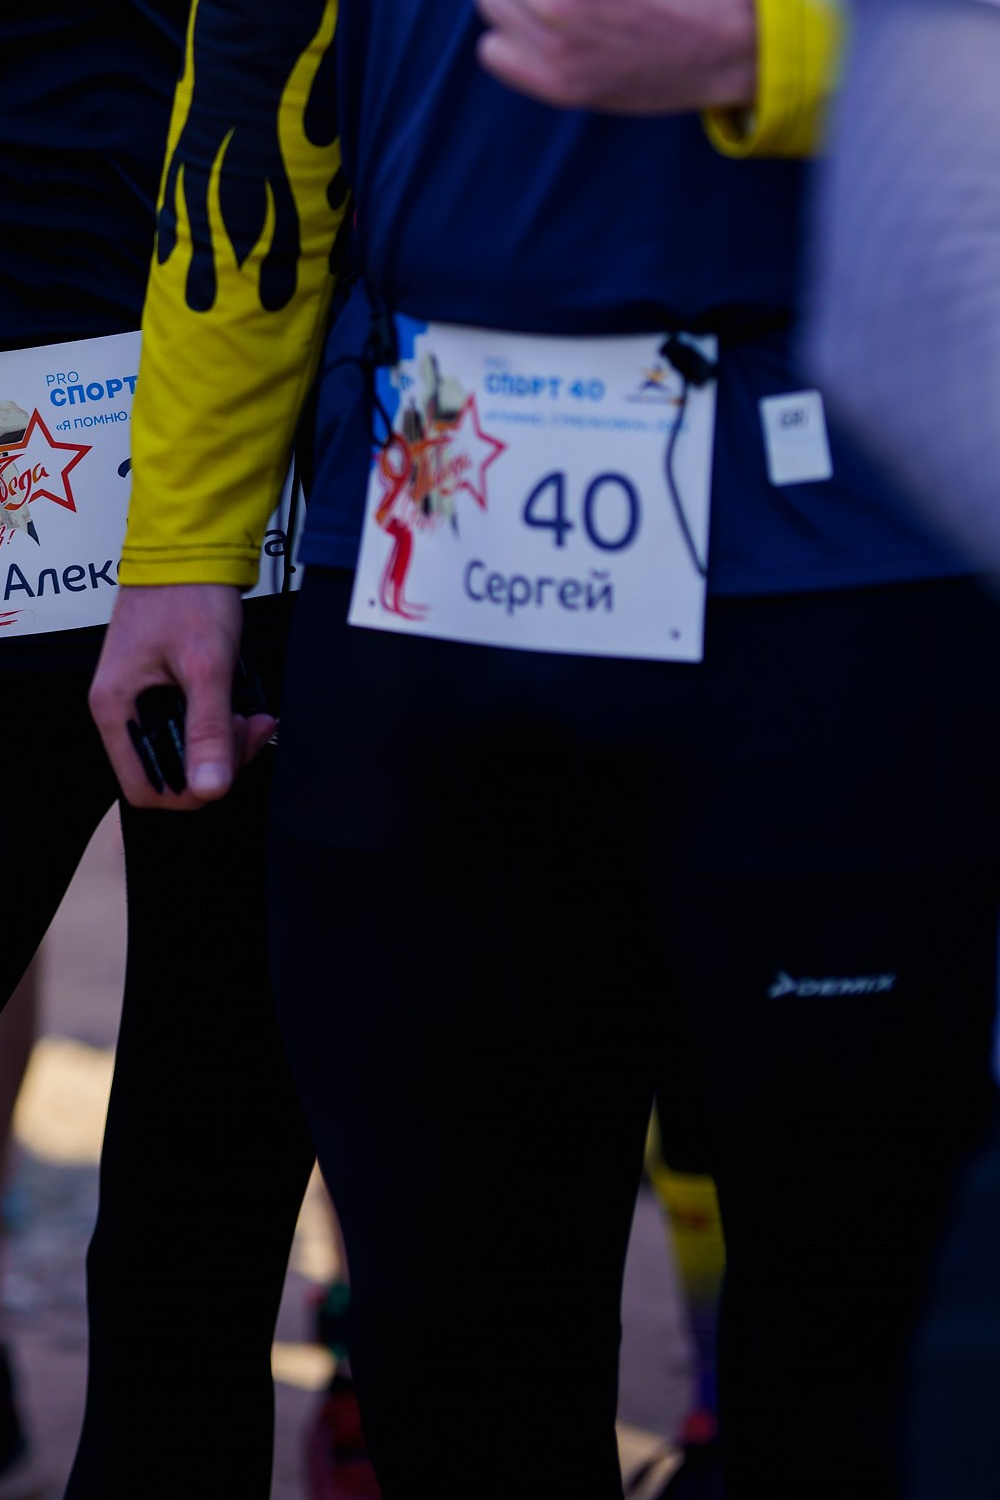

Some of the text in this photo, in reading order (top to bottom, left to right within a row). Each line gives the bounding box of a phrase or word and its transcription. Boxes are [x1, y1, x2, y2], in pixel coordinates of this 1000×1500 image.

[46, 371, 79, 387] PRO
[50, 375, 139, 407] СПОРТ
[485, 372, 561, 399] СПОРТ
[569, 378, 606, 403] 40
[521, 470, 642, 553] 40
[463, 559, 615, 616] Сергей
[797, 972, 896, 998] DEMIX
